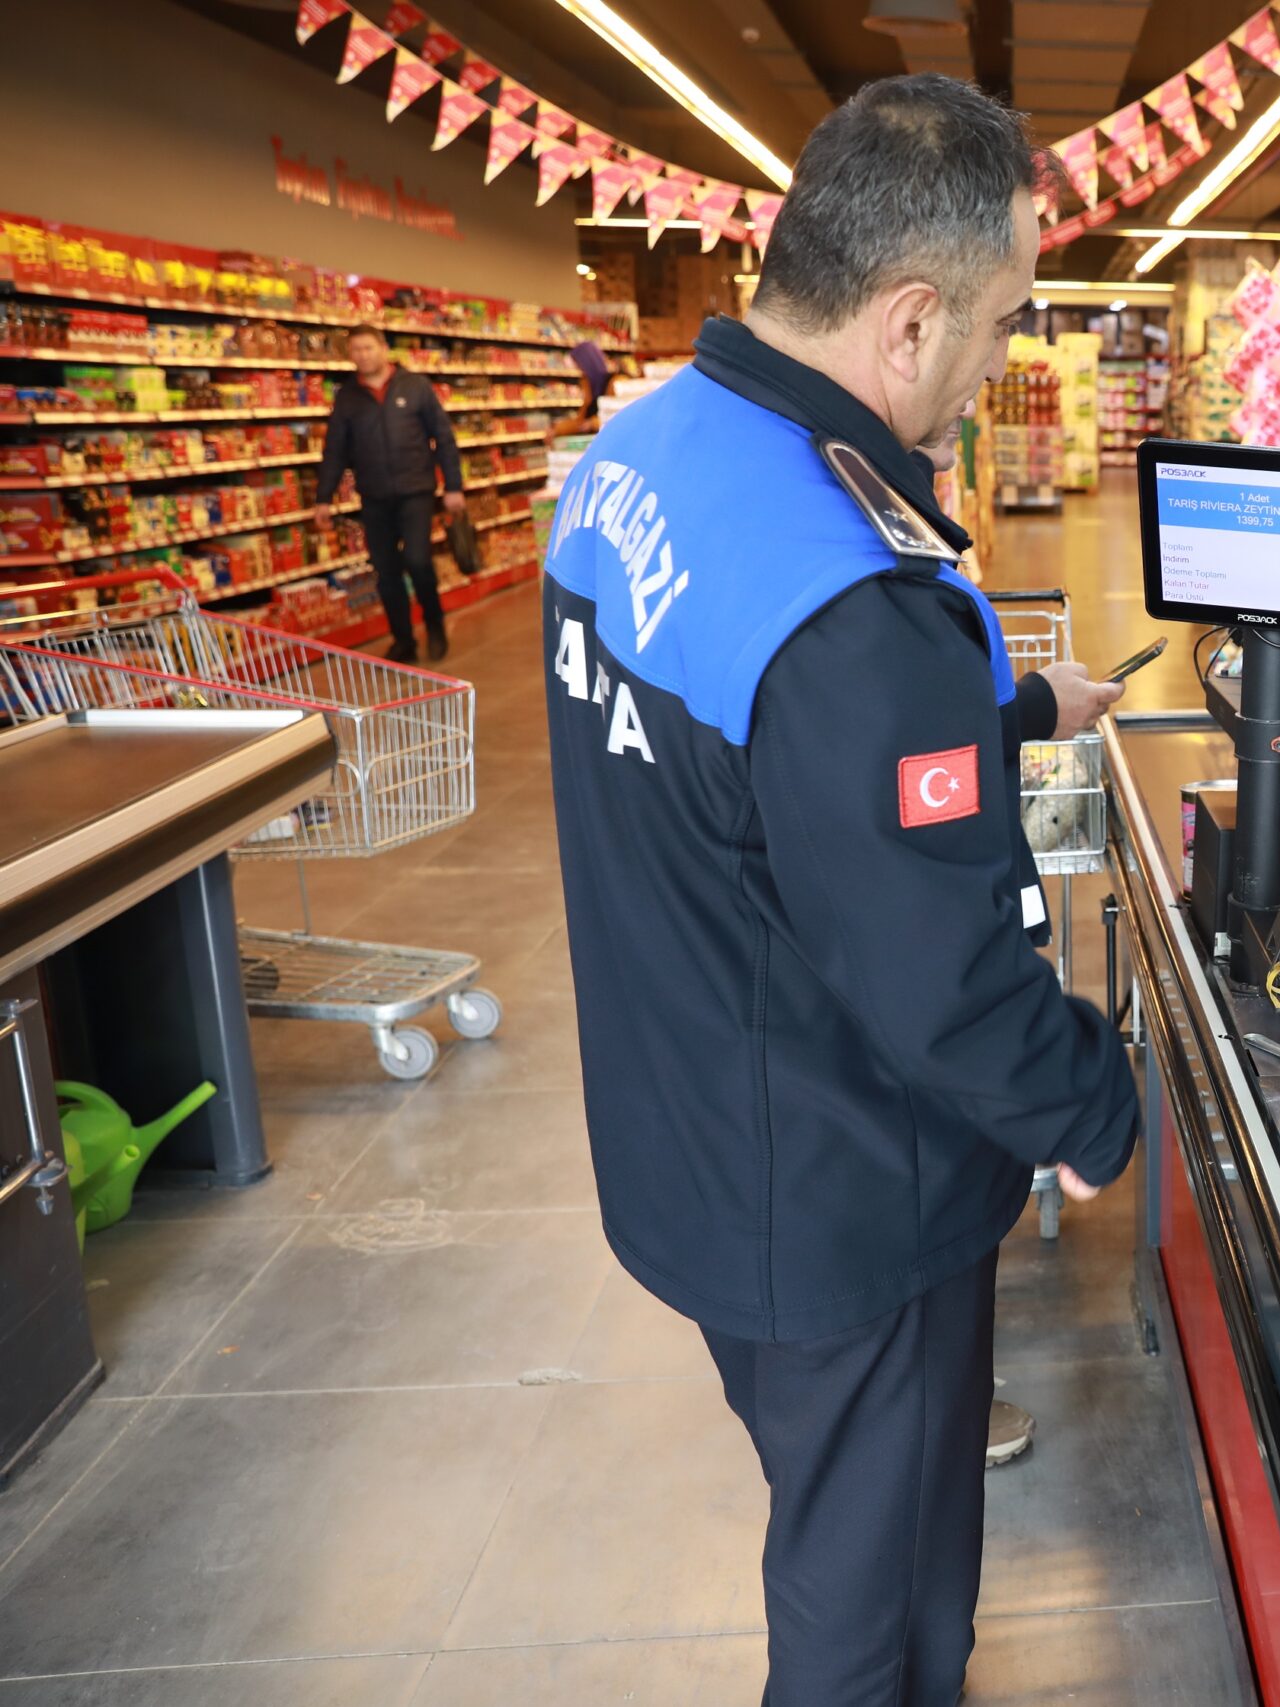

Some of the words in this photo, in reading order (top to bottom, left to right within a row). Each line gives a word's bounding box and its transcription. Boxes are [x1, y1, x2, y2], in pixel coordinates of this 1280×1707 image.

[1239, 492, 1245, 501] 1
[1247, 493, 1270, 503] Adet
[1167, 498, 1198, 511] TARİŞ
[1236, 515, 1274, 527] 1399,75
[1162, 542, 1193, 551] Toplam
[1163, 579, 1188, 588] Kalan
[1189, 581, 1210, 590] Tutar
[1164, 591, 1184, 599] Para
